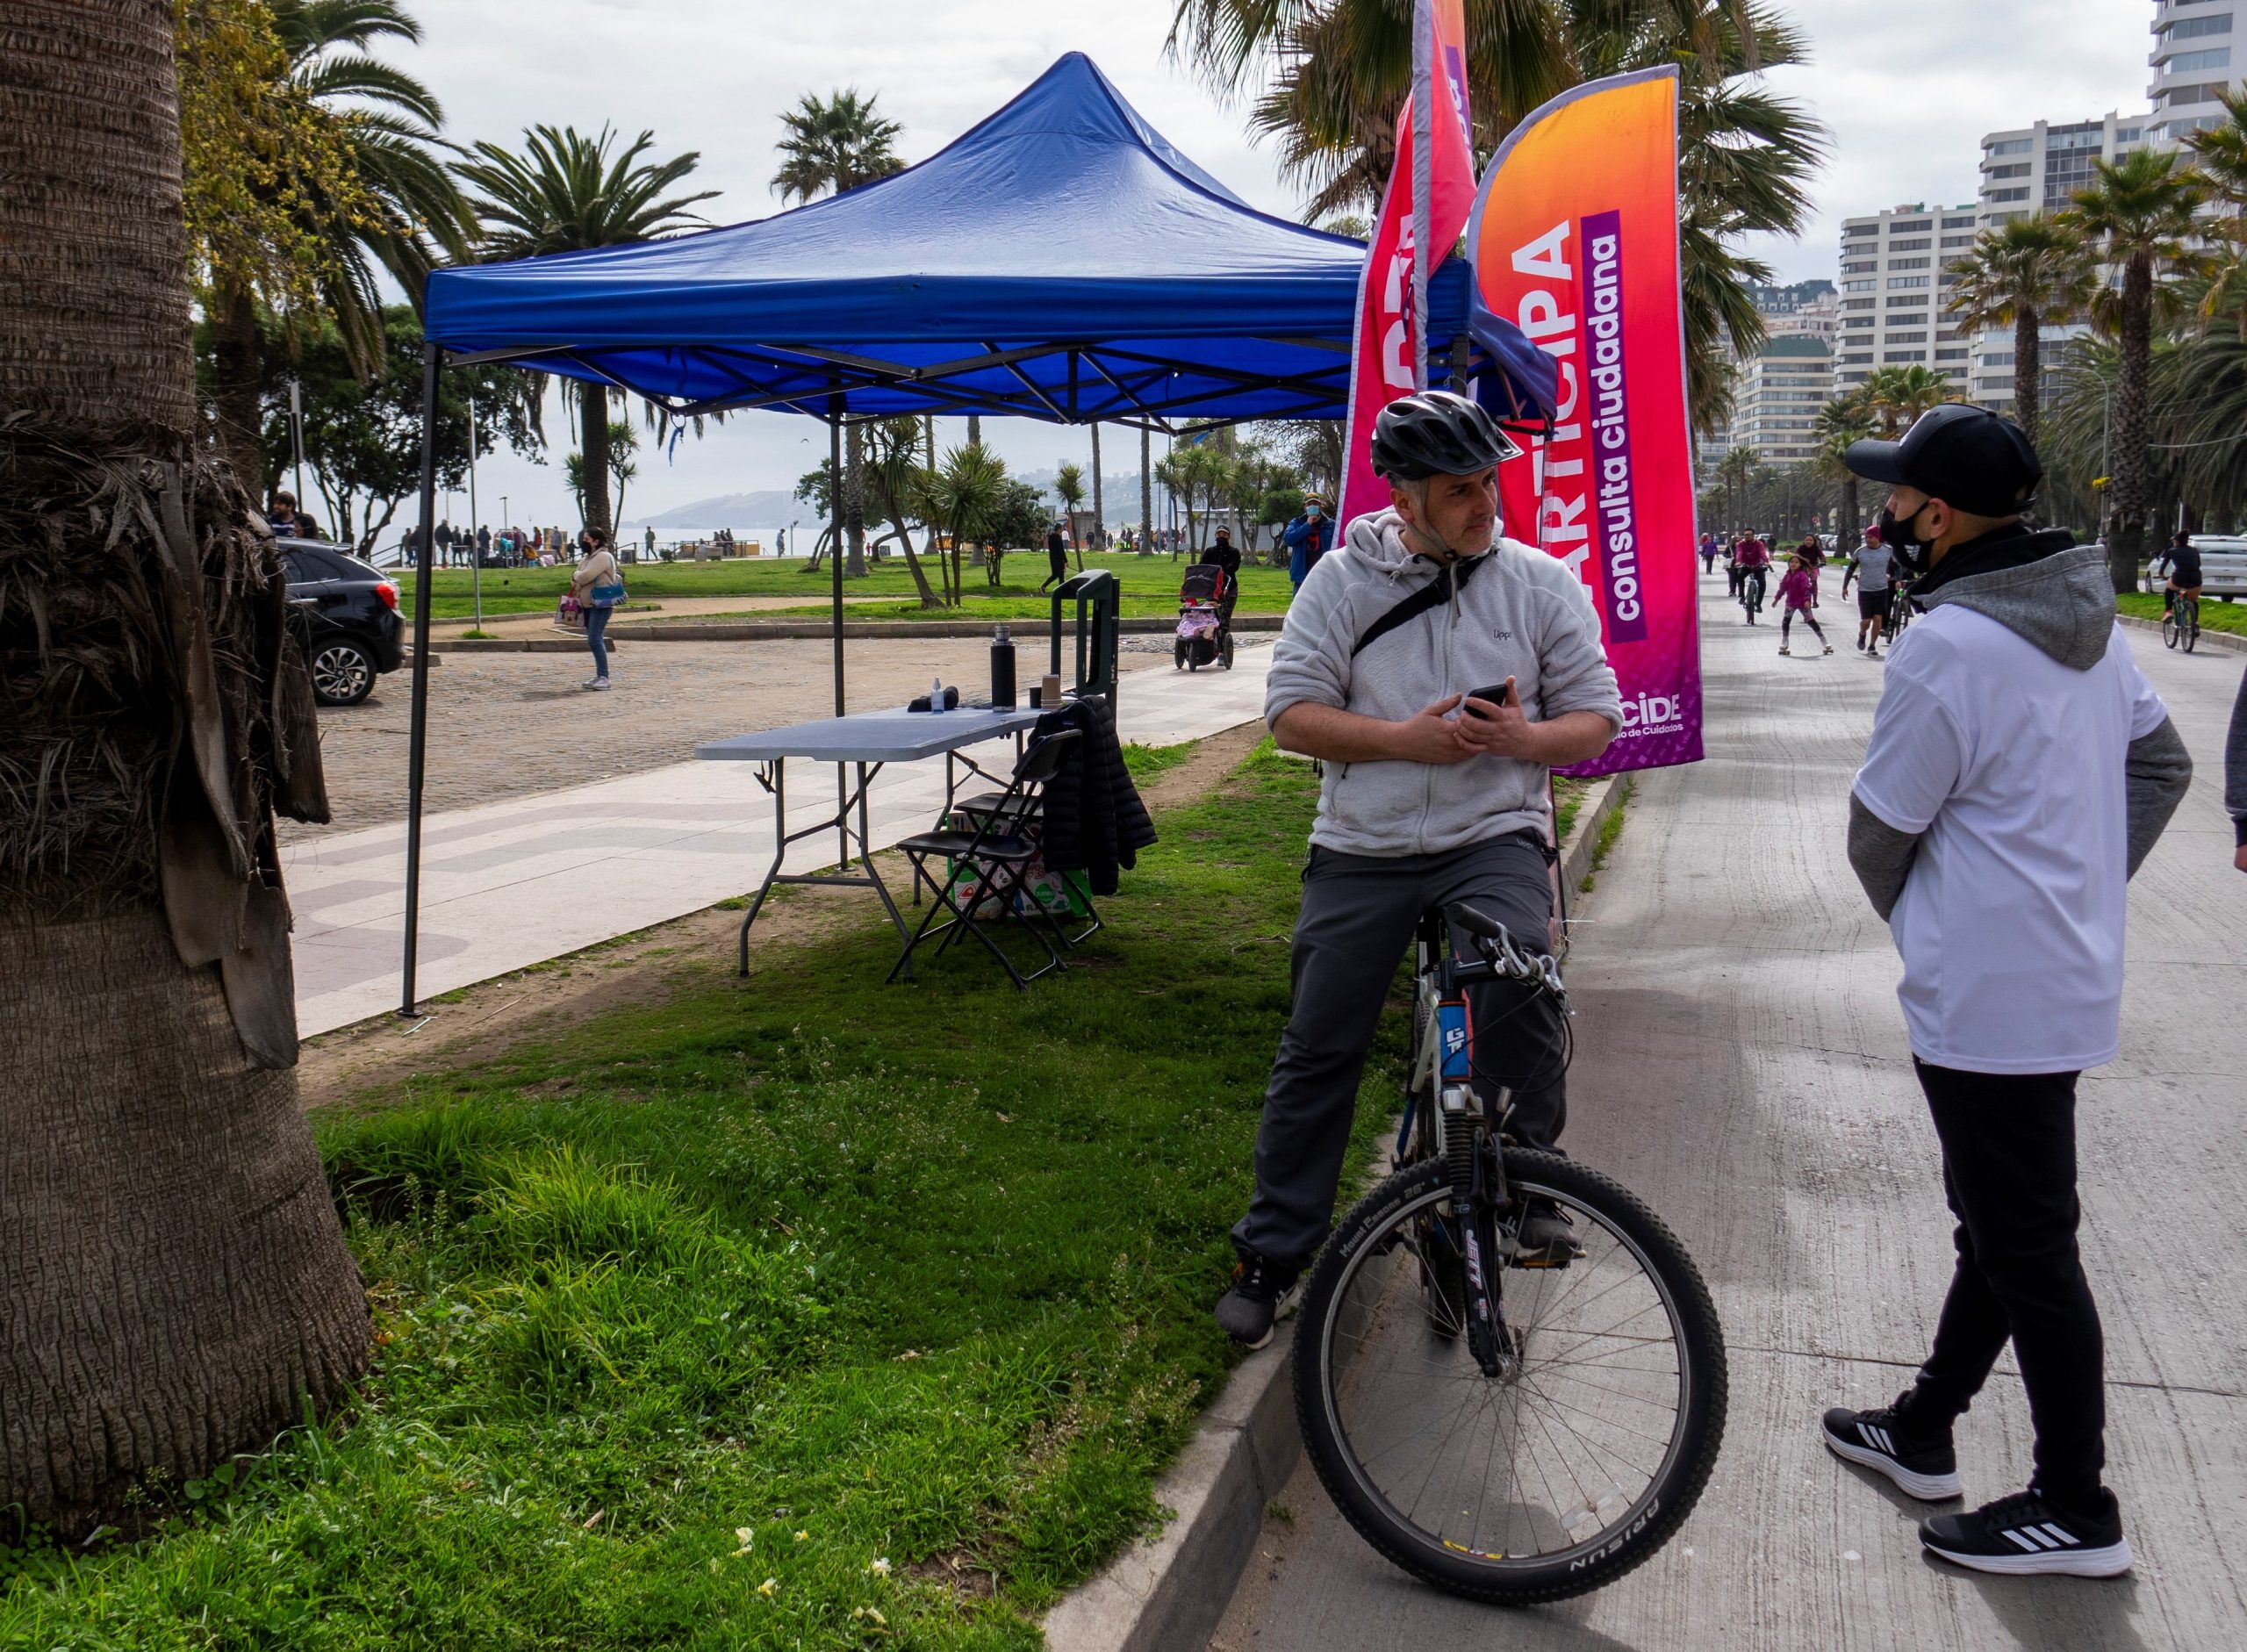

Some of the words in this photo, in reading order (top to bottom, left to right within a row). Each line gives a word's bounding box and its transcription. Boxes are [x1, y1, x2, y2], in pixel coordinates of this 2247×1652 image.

[1588, 234, 1626, 449] ciudadana
[1600, 456, 1640, 621] consulta
[1628, 729, 1641, 737] de
[1642, 723, 1683, 736] Cuidados
[1466, 1229, 1482, 1289] JETT
[1570, 1498, 1659, 1571] ARISUN
